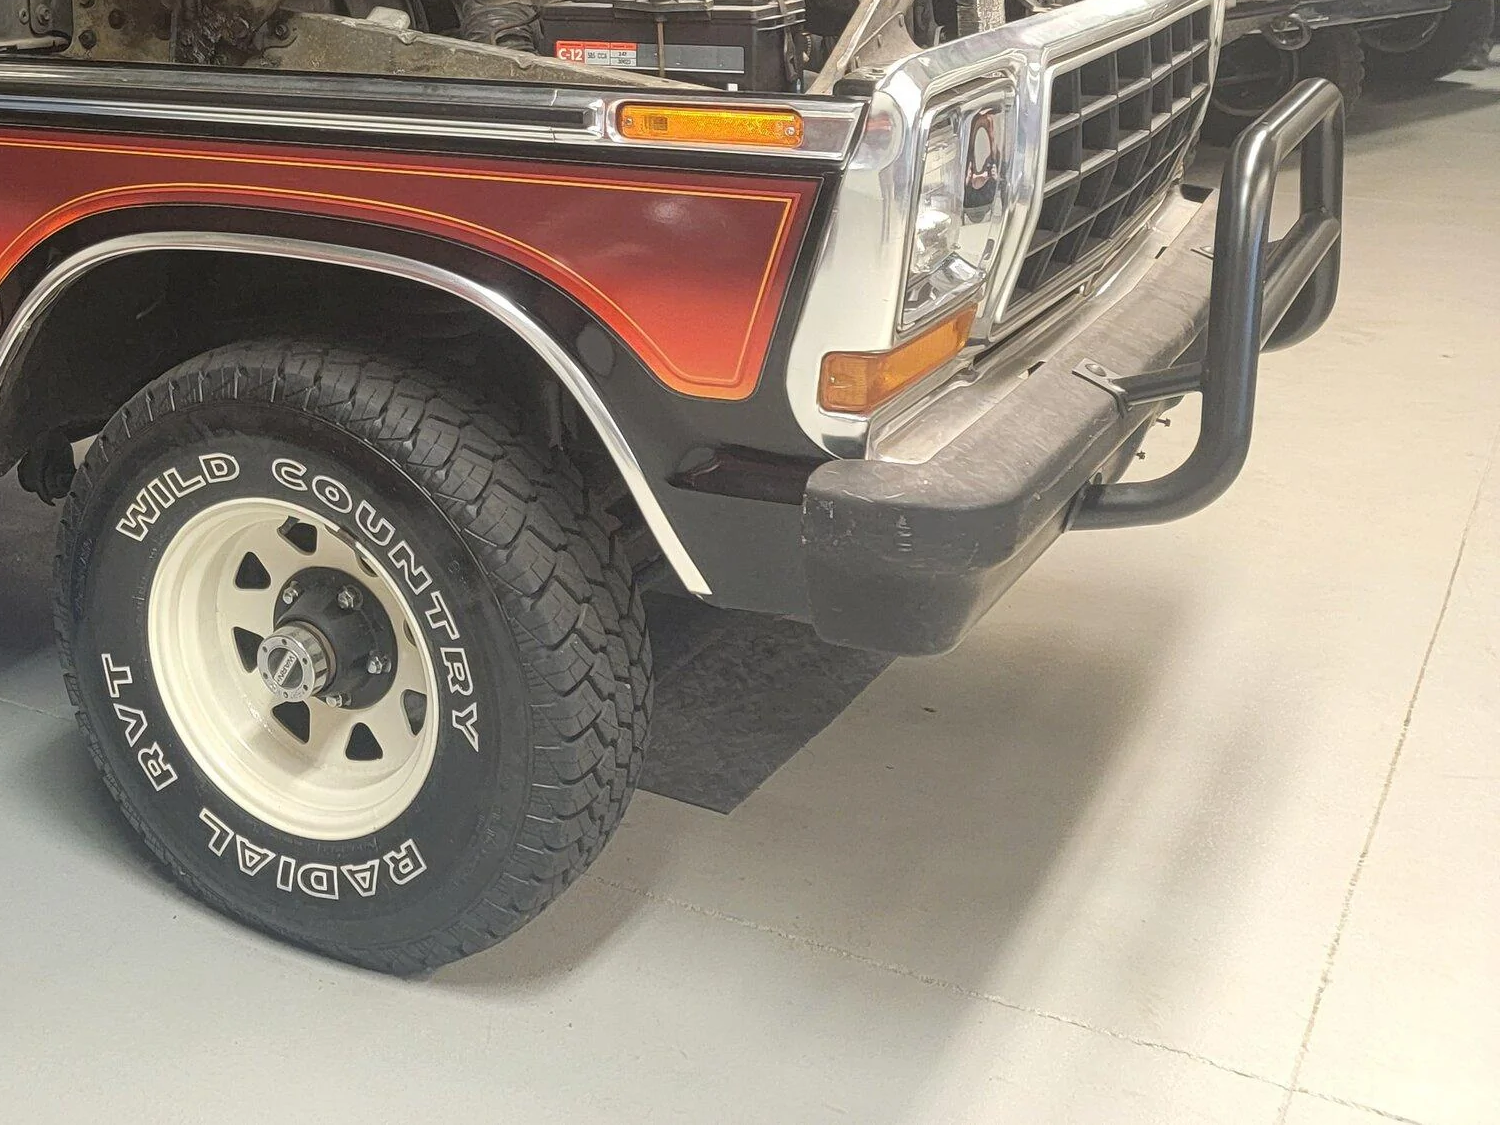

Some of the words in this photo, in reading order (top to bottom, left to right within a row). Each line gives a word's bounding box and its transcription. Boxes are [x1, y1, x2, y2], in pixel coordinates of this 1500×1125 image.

[559, 48, 583, 61] C-12
[116, 452, 240, 542] WILD
[271, 458, 480, 753] COUNTRY
[276, 654, 296, 683] WARN
[101, 652, 179, 792] RVT
[199, 807, 427, 900] RADIAL
